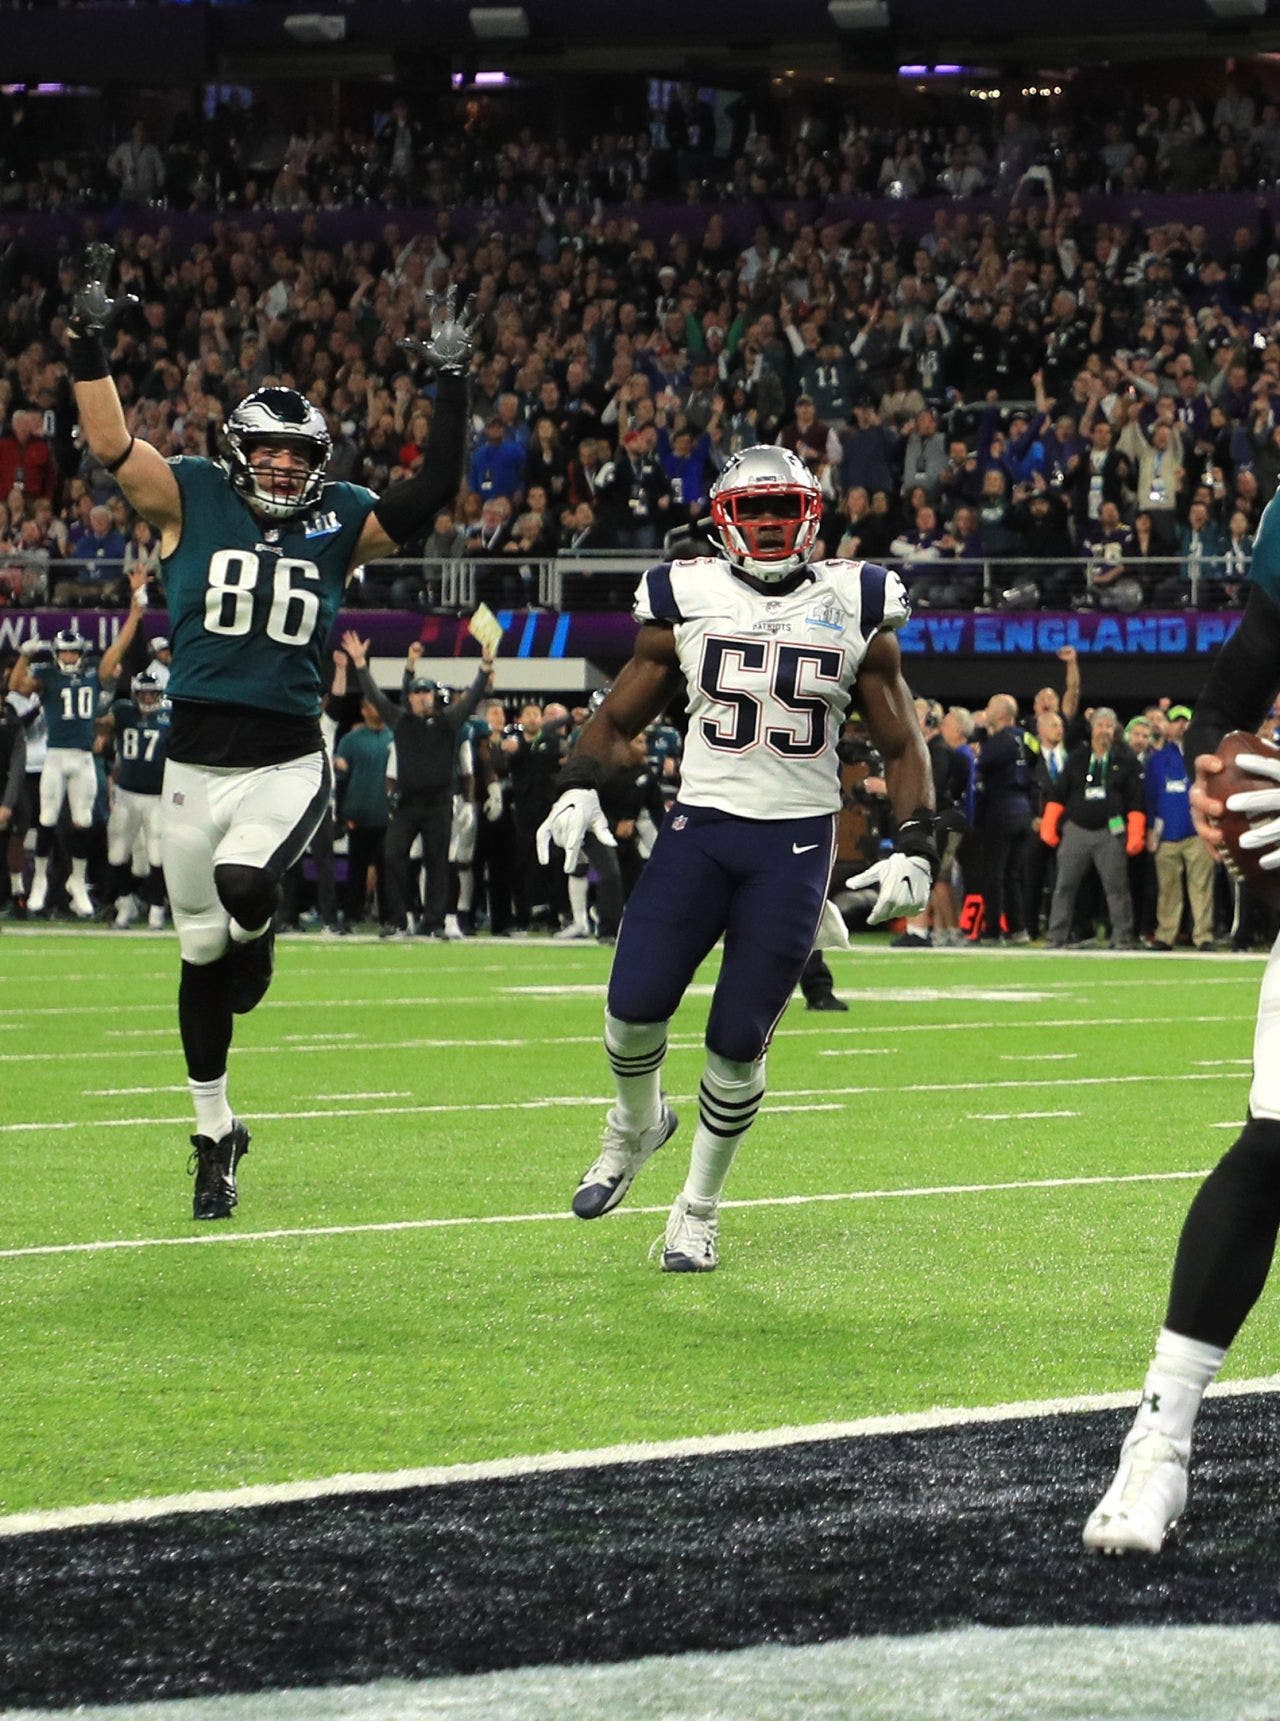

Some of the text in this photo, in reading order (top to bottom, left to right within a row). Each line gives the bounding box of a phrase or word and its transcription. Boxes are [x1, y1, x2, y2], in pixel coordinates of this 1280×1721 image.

[204, 549, 320, 646] 86
[752, 623, 792, 632] PATRIOTS
[974, 617, 1187, 652] ENGLAND
[60, 686, 94, 720] 10
[697, 633, 846, 759] 55
[123, 728, 160, 761] 87
